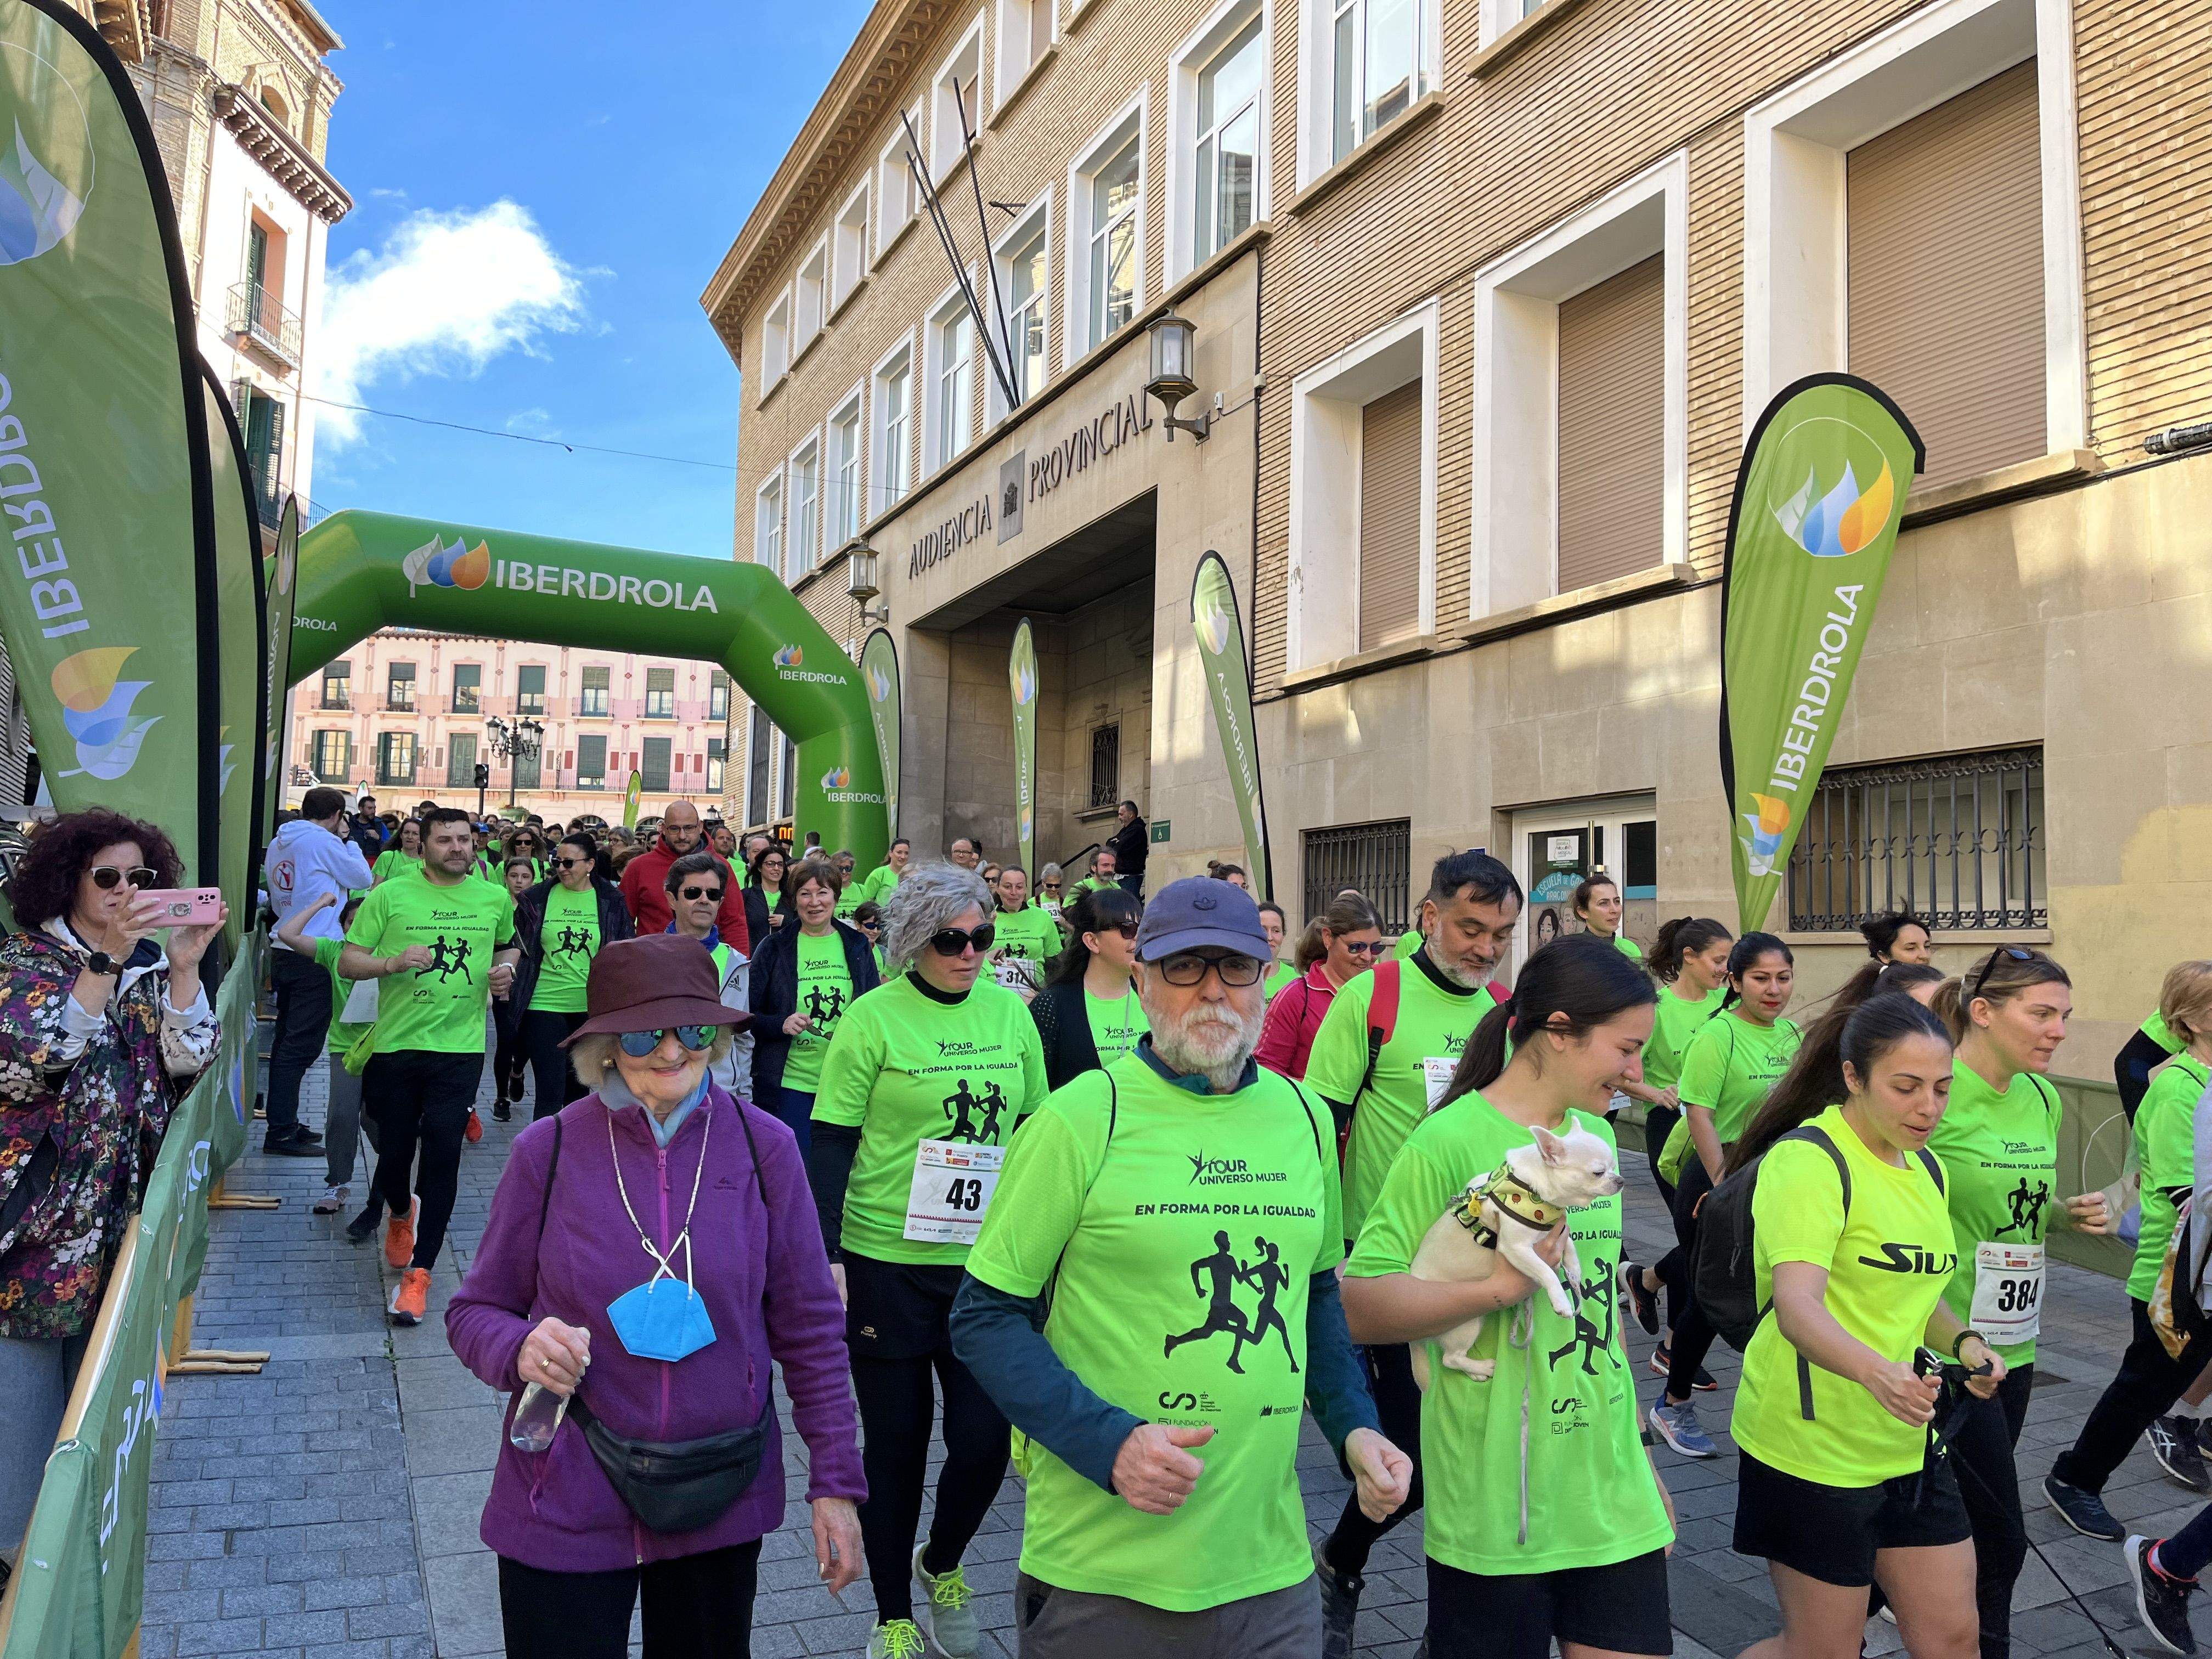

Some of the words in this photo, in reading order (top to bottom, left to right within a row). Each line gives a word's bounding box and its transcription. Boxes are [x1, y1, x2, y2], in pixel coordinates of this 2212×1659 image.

[909, 494, 992, 579] AUDIENCIA
[1029, 384, 1153, 502] PROVINCIAL
[496, 560, 718, 614] IBERDROLA
[293, 616, 337, 631] DROLA
[780, 670, 847, 685] IBERDROLA
[1770, 585, 1864, 791] IBERDROLA
[828, 793, 887, 804] IBERDROLA
[1537, 873, 1561, 896] ESCUELA
[948, 1042, 974, 1051] TOUR
[979, 1045, 1002, 1053] MUJER
[922, 1065, 953, 1074] FORMA
[1206, 1159, 1248, 1173] TOUR
[1199, 1173, 1253, 1185] UNIVERSO
[1256, 1172, 1287, 1182] MUJER
[946, 1178, 982, 1211] 43
[1135, 1204, 1155, 1215] EN
[1160, 1204, 1210, 1215] FORMA
[1214, 1204, 1239, 1215] POR
[1244, 1205, 1260, 1215] LA
[1263, 1205, 1316, 1218] IGUALDAD
[1591, 1200, 1612, 1210] MUJER
[1586, 1231, 1596, 1240] LA
[1998, 1277, 2040, 1312] 384
